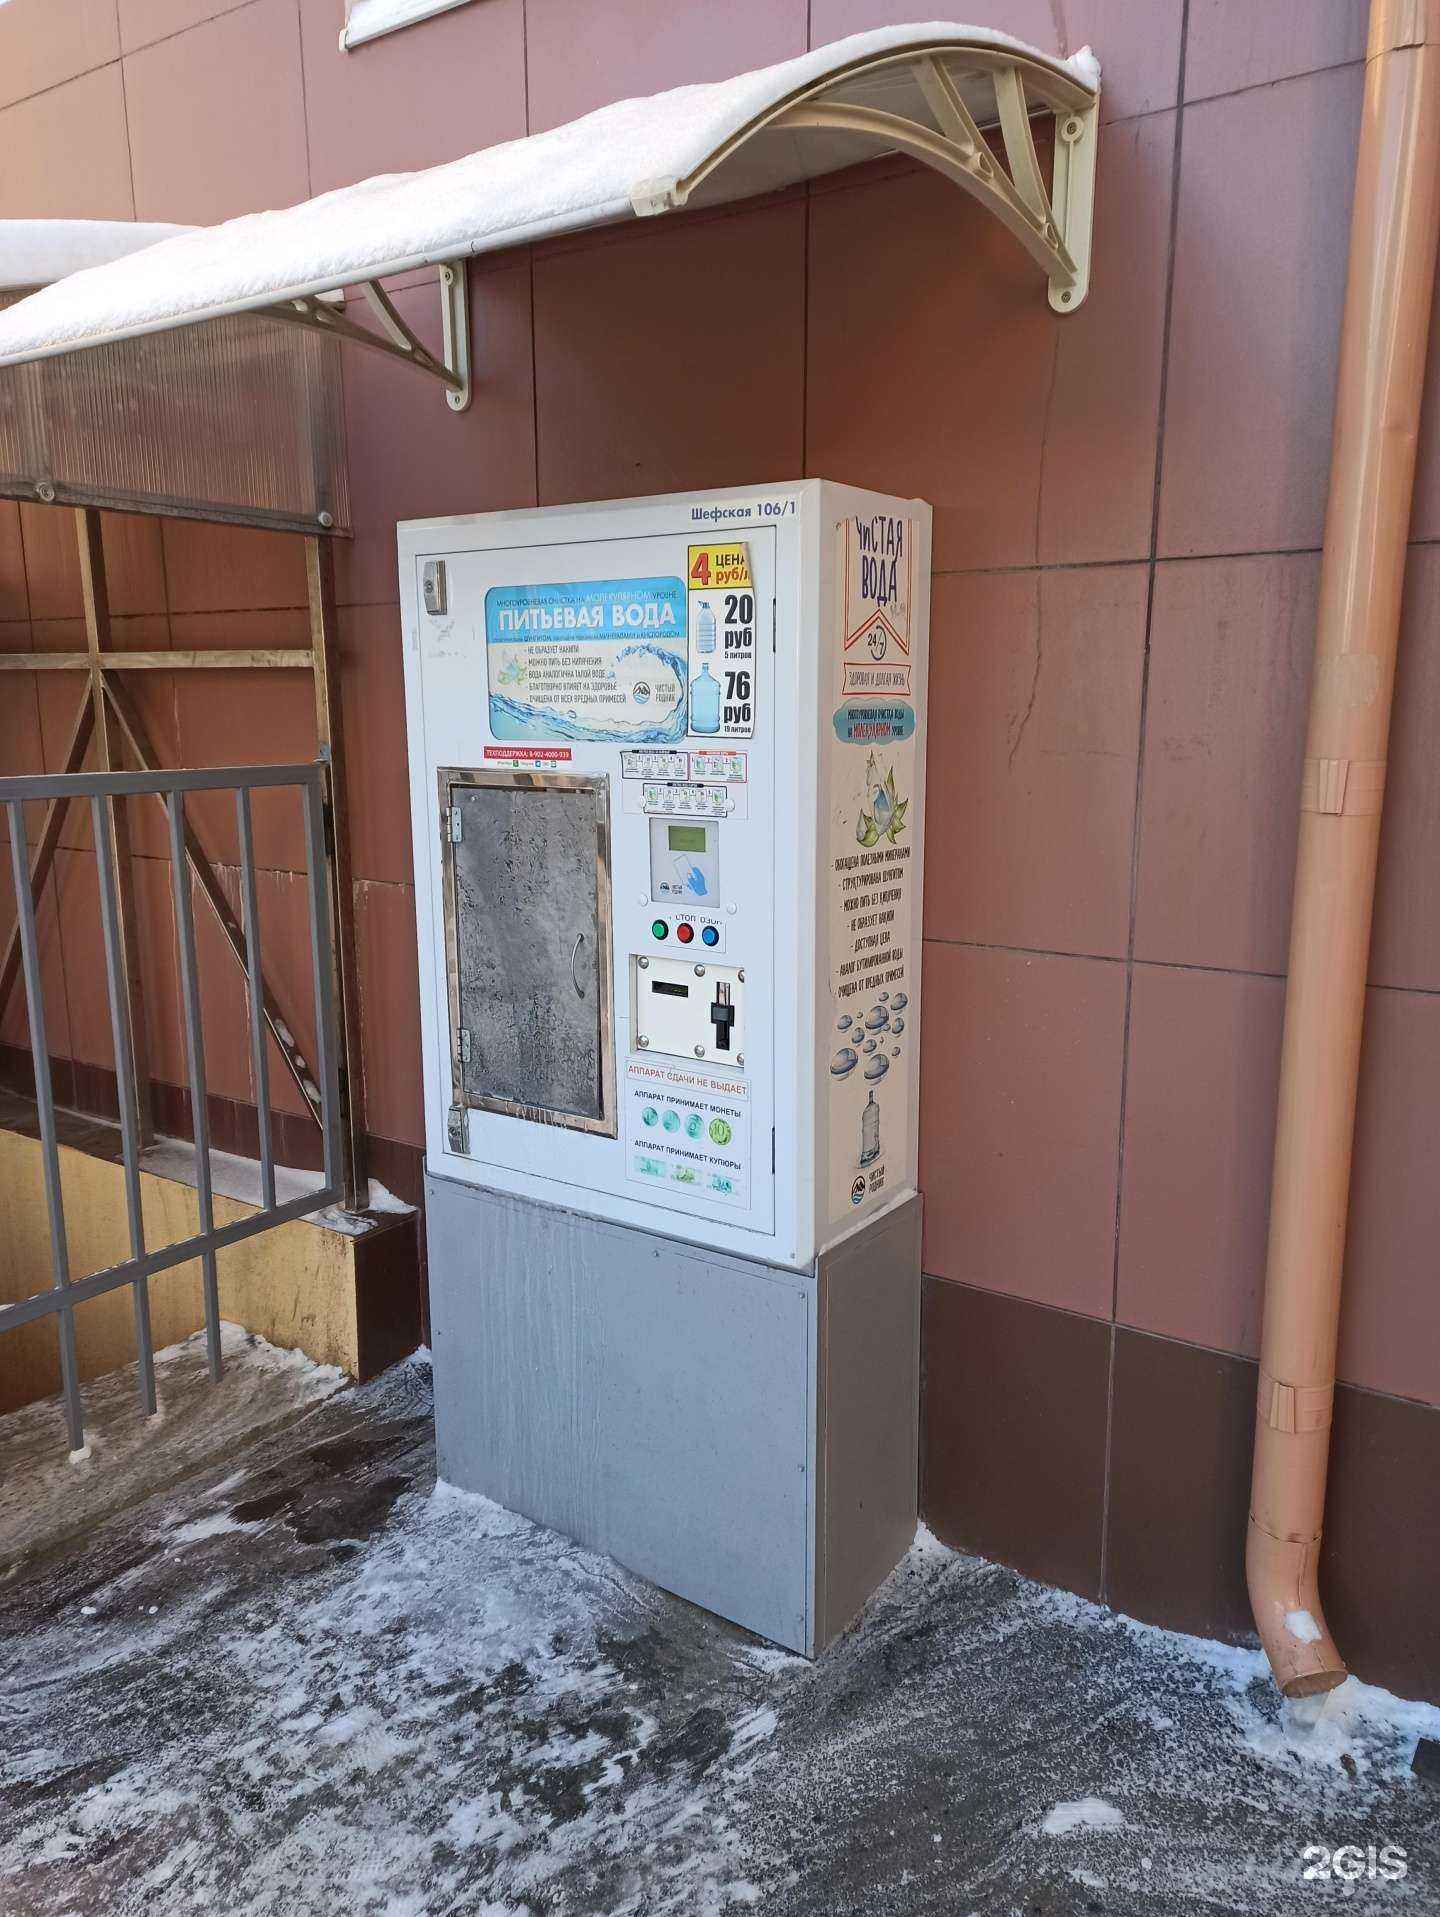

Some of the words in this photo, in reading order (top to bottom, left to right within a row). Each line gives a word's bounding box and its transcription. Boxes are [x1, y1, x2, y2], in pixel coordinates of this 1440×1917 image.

[691, 507, 752, 522] Шефская
[757, 501, 796, 516] 106/1
[691, 552, 711, 585] 4
[862, 555, 898, 607] ВОДА
[499, 605, 604, 631] ПИТЬЕВАЯ
[612, 601, 676, 629] ВОДА
[724, 594, 754, 624] 20
[724, 627, 752, 650] руб
[528, 658, 548, 667] МОЖНО
[561, 658, 571, 666] БЕЗ
[724, 651, 729, 659] 5
[729, 651, 752, 660] литров
[528, 670, 542, 679] ВОДА
[582, 682, 591, 690] НА
[724, 671, 751, 701] 76
[553, 695, 560, 703] ОТ
[560, 694, 573, 703] ВСЕХ
[723, 703, 752, 724] руб
[729, 725, 752, 734] литров
[628, 1065, 665, 1080] АППАРАТ
[666, 1072, 695, 1084] СДАЧИ
[696, 1077, 709, 1088] НЕ
[710, 1081, 747, 1095] ВЫДАЕТ
[634, 1090, 665, 1102] АППАРАТ
[666, 1096, 708, 1111] ПРИНИМАЕТ
[709, 1105, 742, 1118] МОНЕТЫ
[634, 1140, 665, 1152] АППАРАТ
[666, 1146, 708, 1162] ПРИНИМАЕТ
[709, 1156, 742, 1170] КУПЮРЫ
